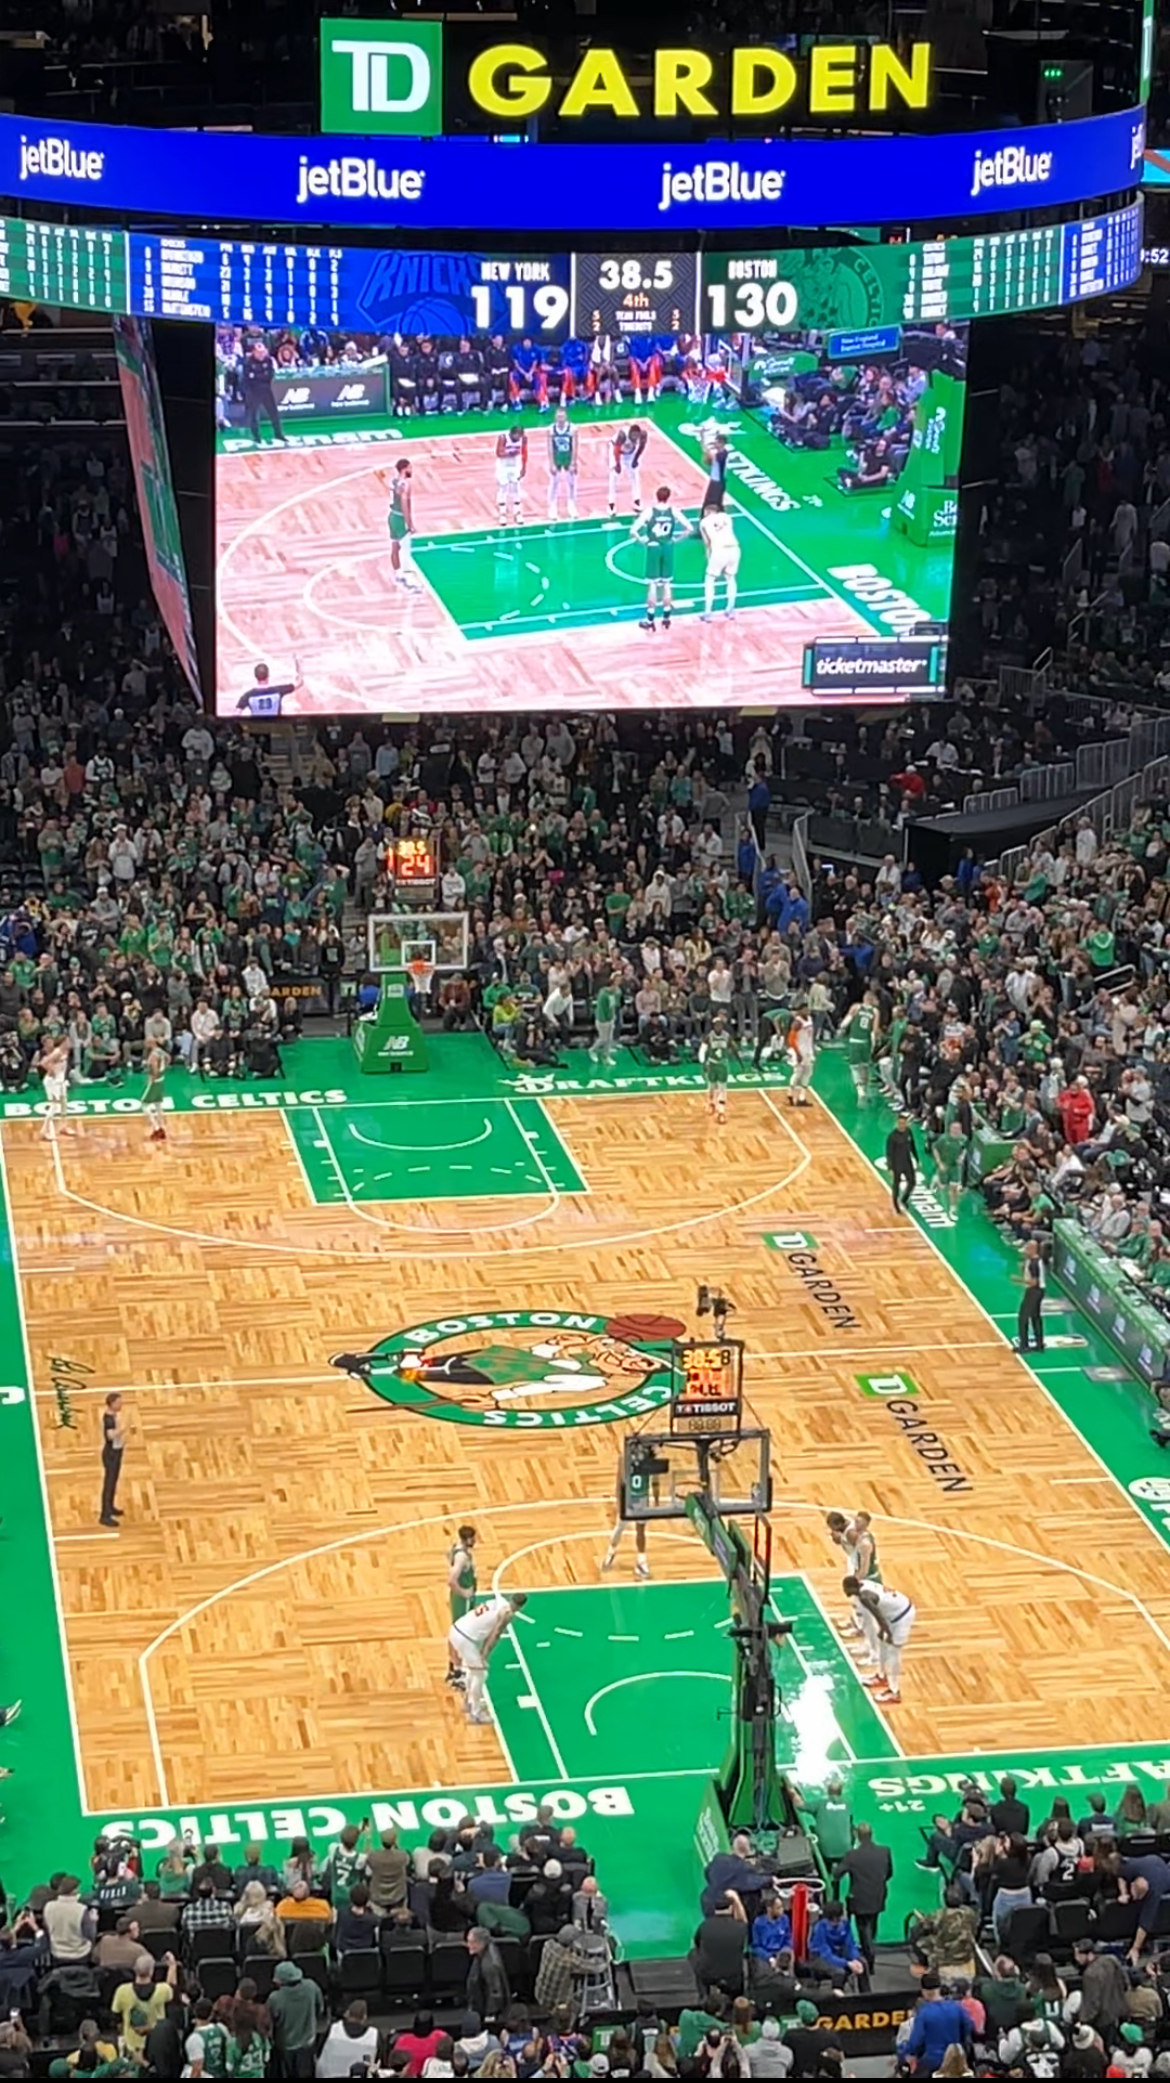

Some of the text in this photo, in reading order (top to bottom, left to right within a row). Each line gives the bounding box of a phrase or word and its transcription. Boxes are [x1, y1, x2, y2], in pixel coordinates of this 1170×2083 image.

[331, 39, 931, 117] TD GARDEN
[19, 135, 104, 181] jetBlue
[971, 147, 1052, 196] jetBlue
[297, 157, 424, 204] jetBlue
[658, 161, 786, 211] jetBlue
[481, 262, 550, 281] NEW YORK
[599, 260, 673, 290] 38.5
[728, 259, 778, 279] BOSTON
[471, 285, 569, 329] 119
[623, 292, 650, 307] 4th
[707, 282, 798, 328] 130
[816, 658, 923, 675] ticketmaster
[401, 854, 430, 876] 24
[267, 985, 322, 998] ARDEN
[191, 1089, 347, 1109] CELTICS
[787, 1252, 862, 1330] GARDEN
[403, 1313, 598, 1344] BOSTON
[482, 1385, 672, 1427] CELTICS
[694, 1402, 736, 1414] TISSOT
[886, 1399, 974, 1493] GARDEN
[632, 1475, 642, 1489] 0
[101, 1786, 635, 1848] BOSTON CELTICS
[1062, 1864, 1075, 1881] 2
